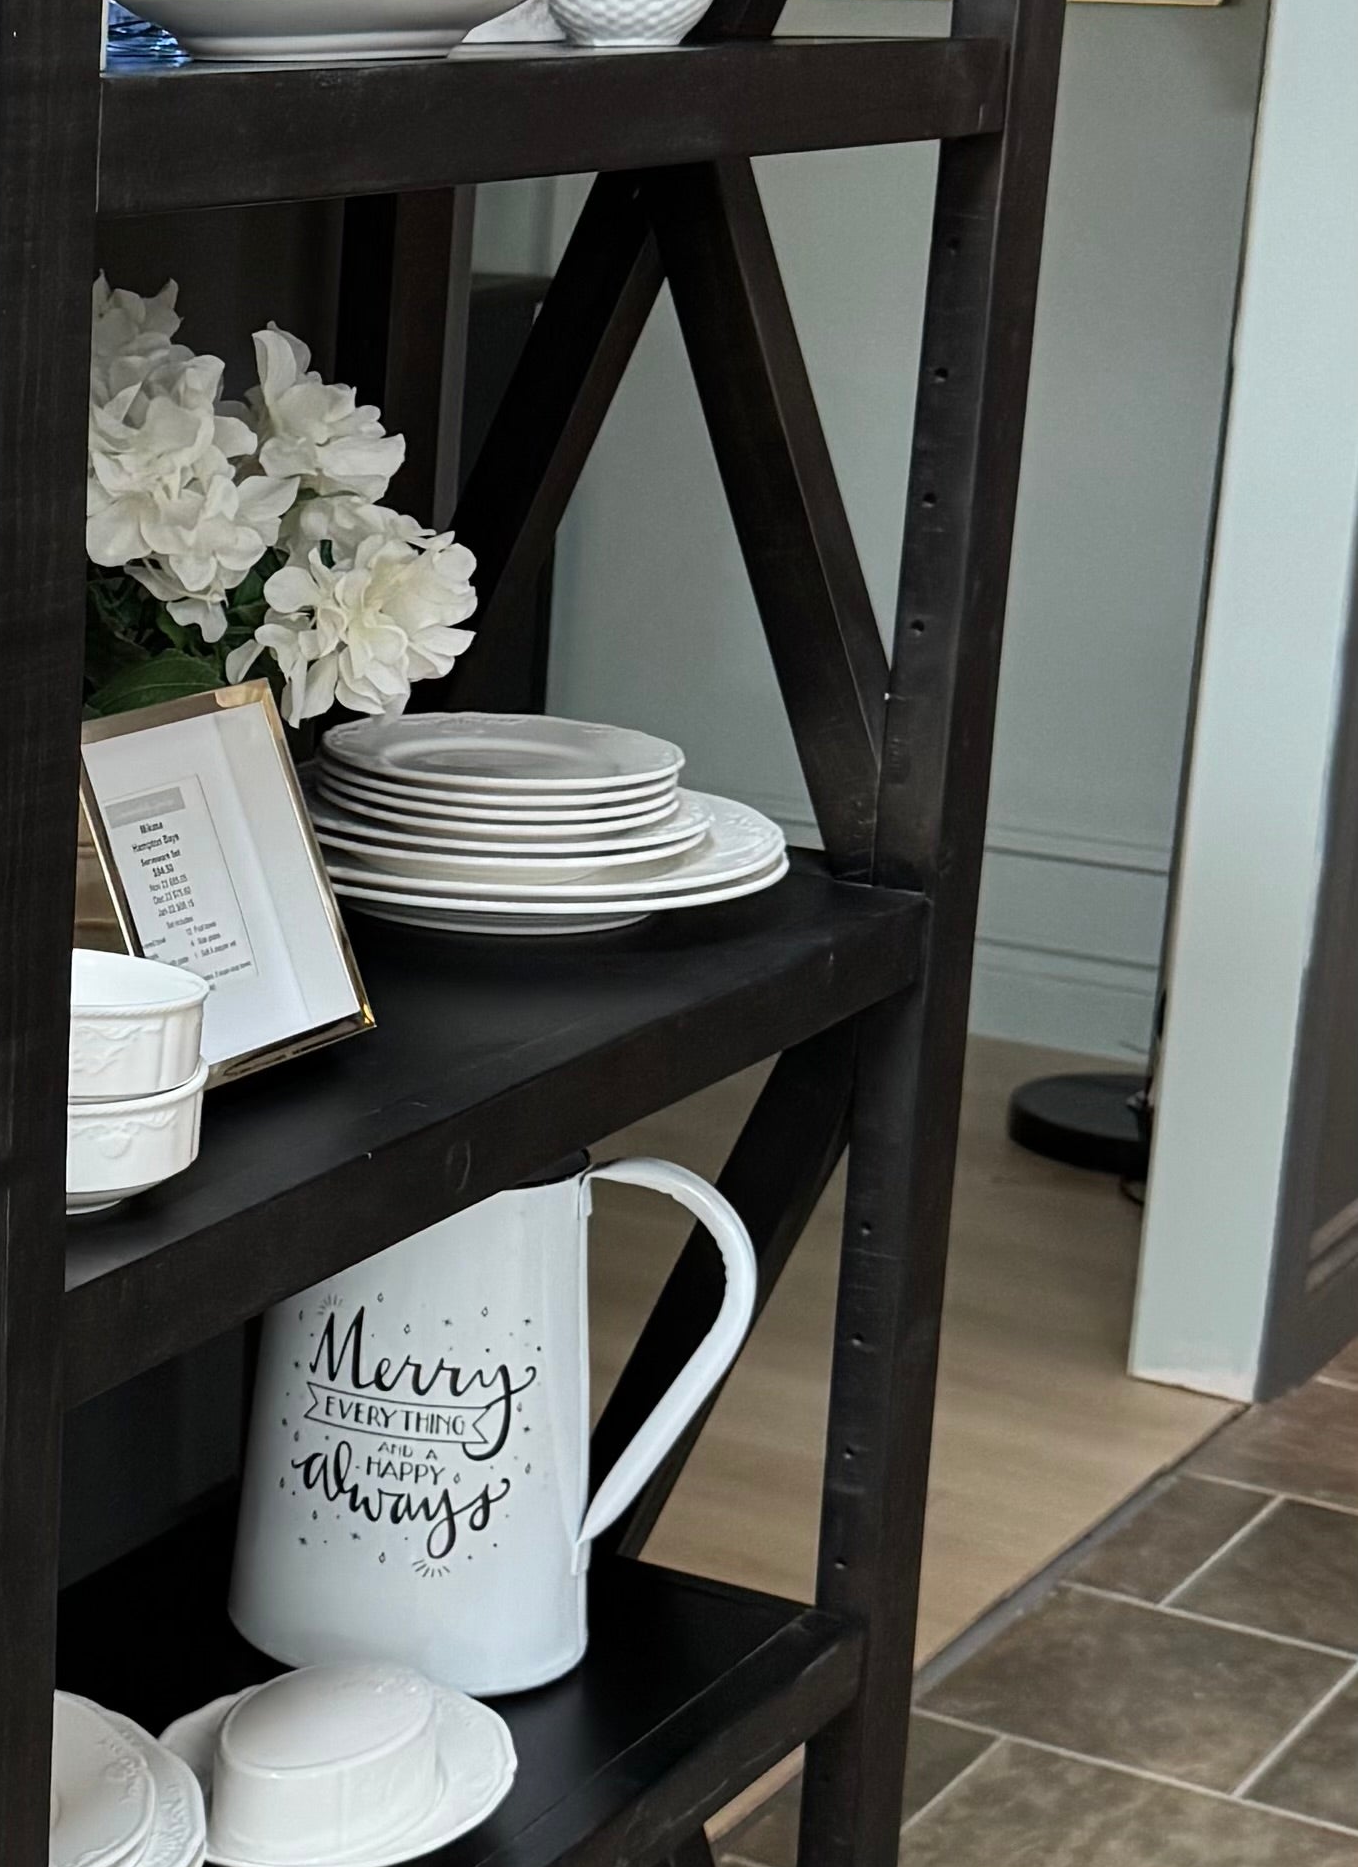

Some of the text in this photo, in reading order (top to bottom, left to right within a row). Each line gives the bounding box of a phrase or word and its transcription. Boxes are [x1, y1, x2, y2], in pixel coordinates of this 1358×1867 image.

[309, 1306, 537, 1461] Merry
[324, 1395, 465, 1436] EVERYTHING
[366, 1456, 446, 1485] HAPPY
[377, 1441, 438, 1460] AND A
[291, 1441, 511, 1559] always
